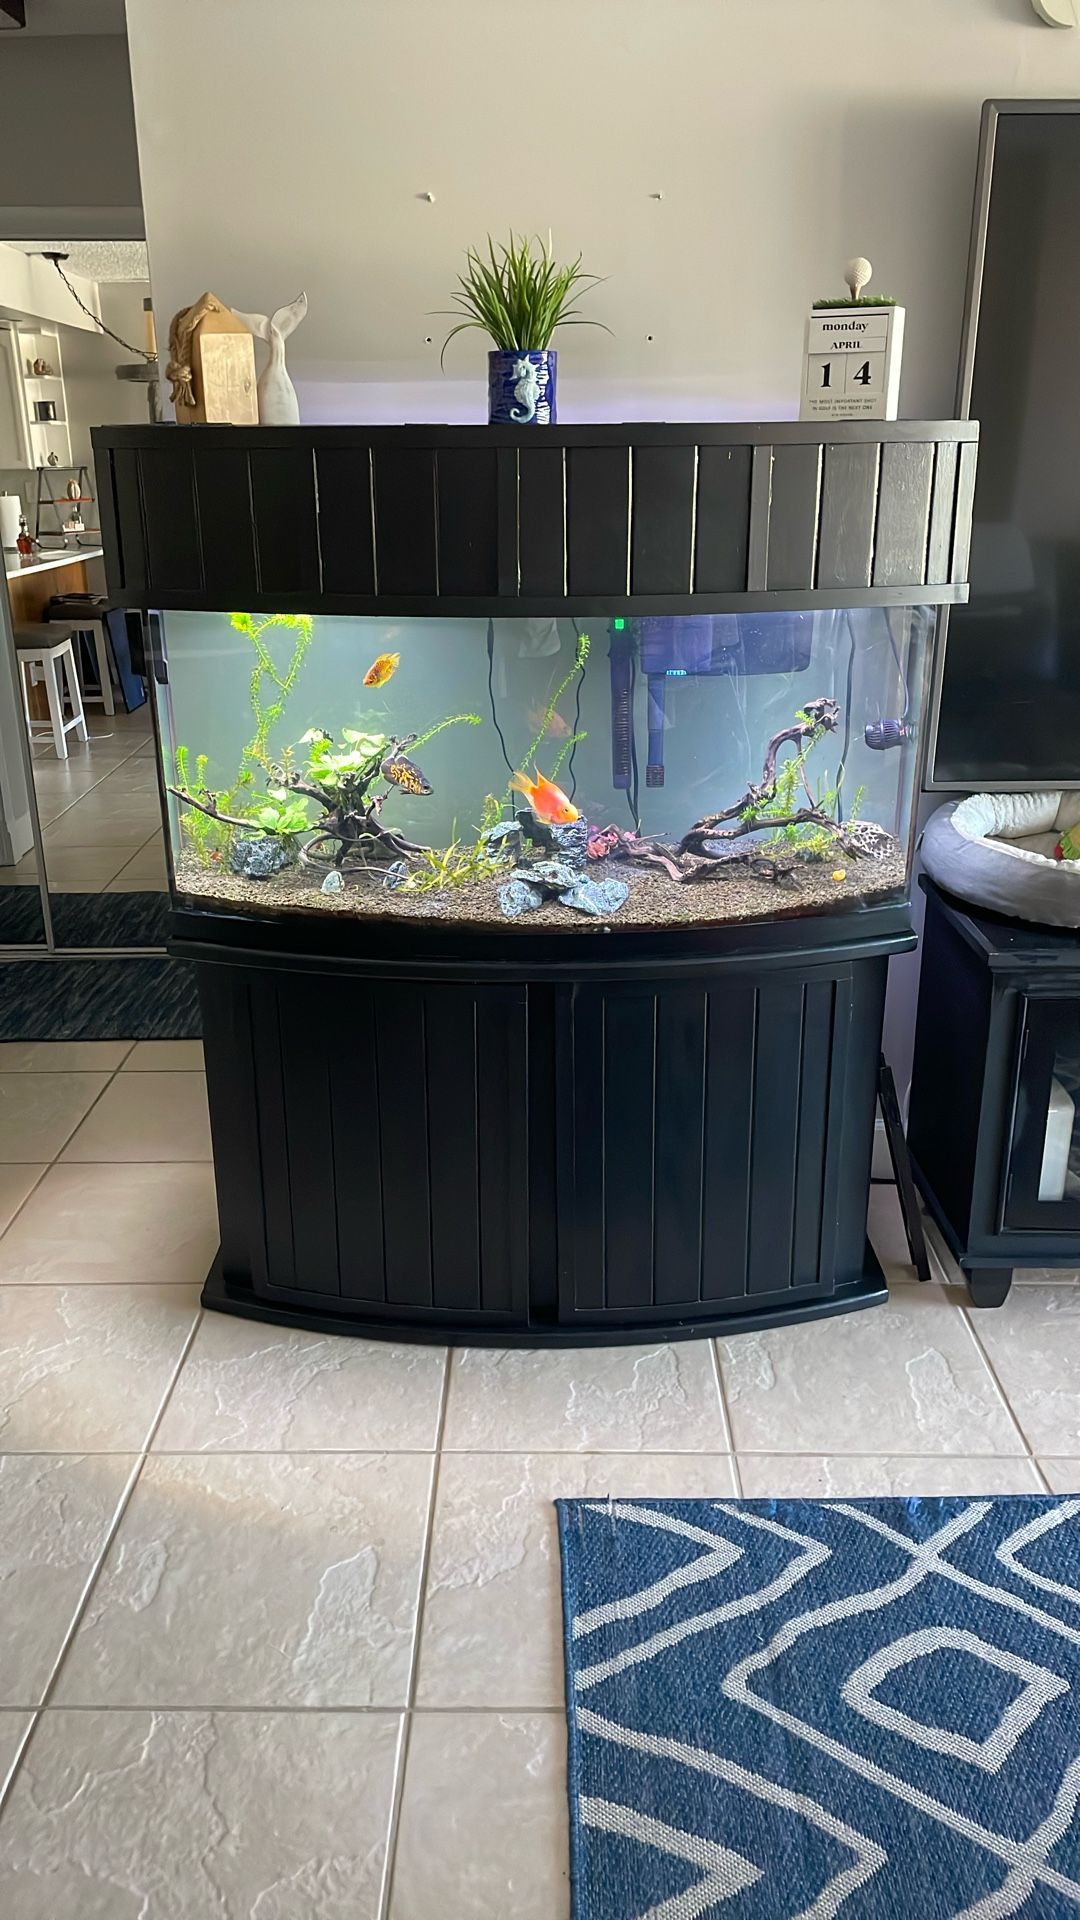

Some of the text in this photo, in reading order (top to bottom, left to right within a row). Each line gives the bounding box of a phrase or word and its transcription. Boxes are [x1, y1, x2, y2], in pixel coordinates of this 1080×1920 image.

[822, 321, 869, 333] monday
[830, 341, 863, 349] APRIL
[820, 360, 872, 388] 1 4
